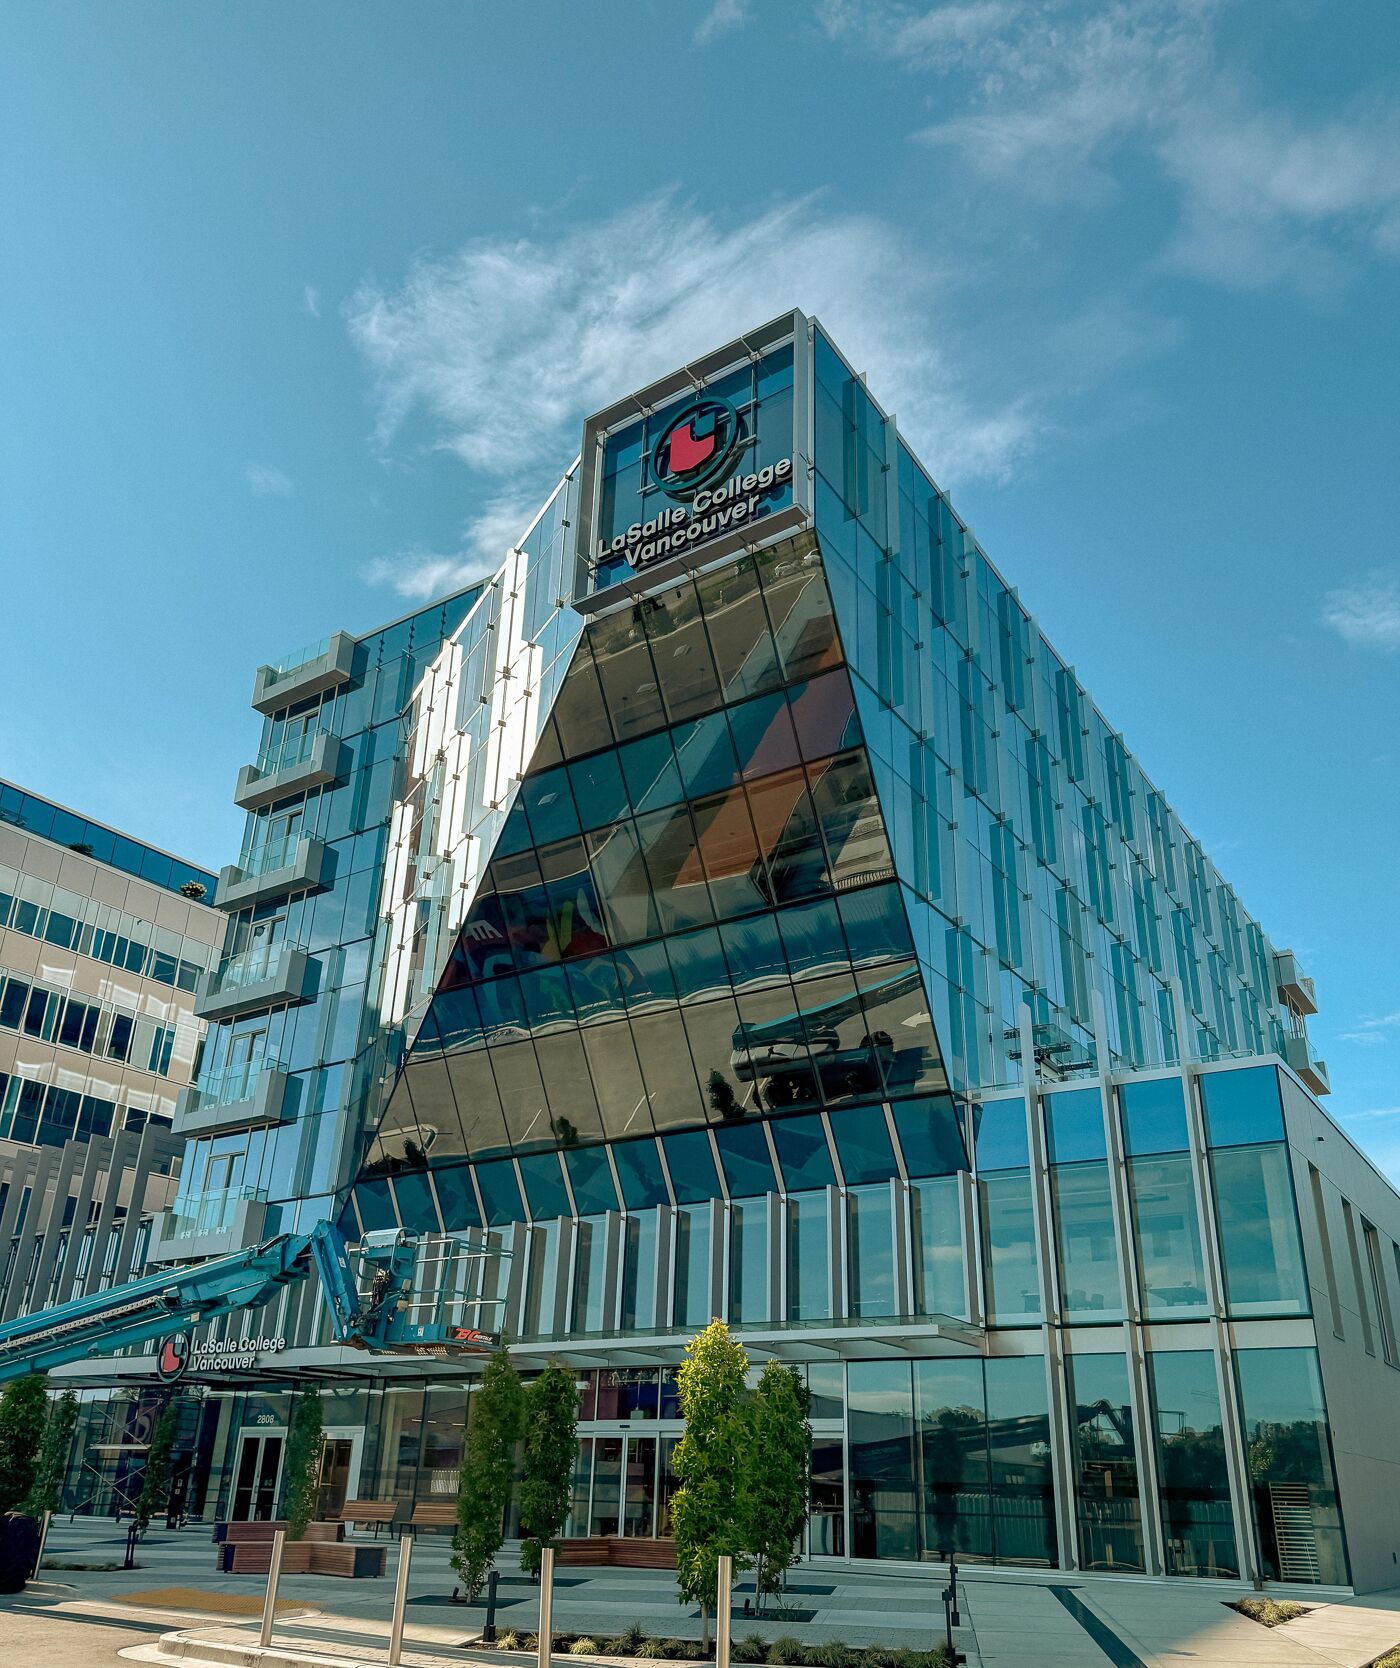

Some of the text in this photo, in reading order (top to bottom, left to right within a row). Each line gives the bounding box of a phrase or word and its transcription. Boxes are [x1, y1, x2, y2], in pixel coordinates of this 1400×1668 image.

[598, 458, 791, 558] LaSalle College
[625, 494, 760, 566] Vancouver
[194, 1335, 286, 1354] LaSalle College
[193, 1355, 255, 1371] Vancouver
[256, 1414, 275, 1424] 2808
